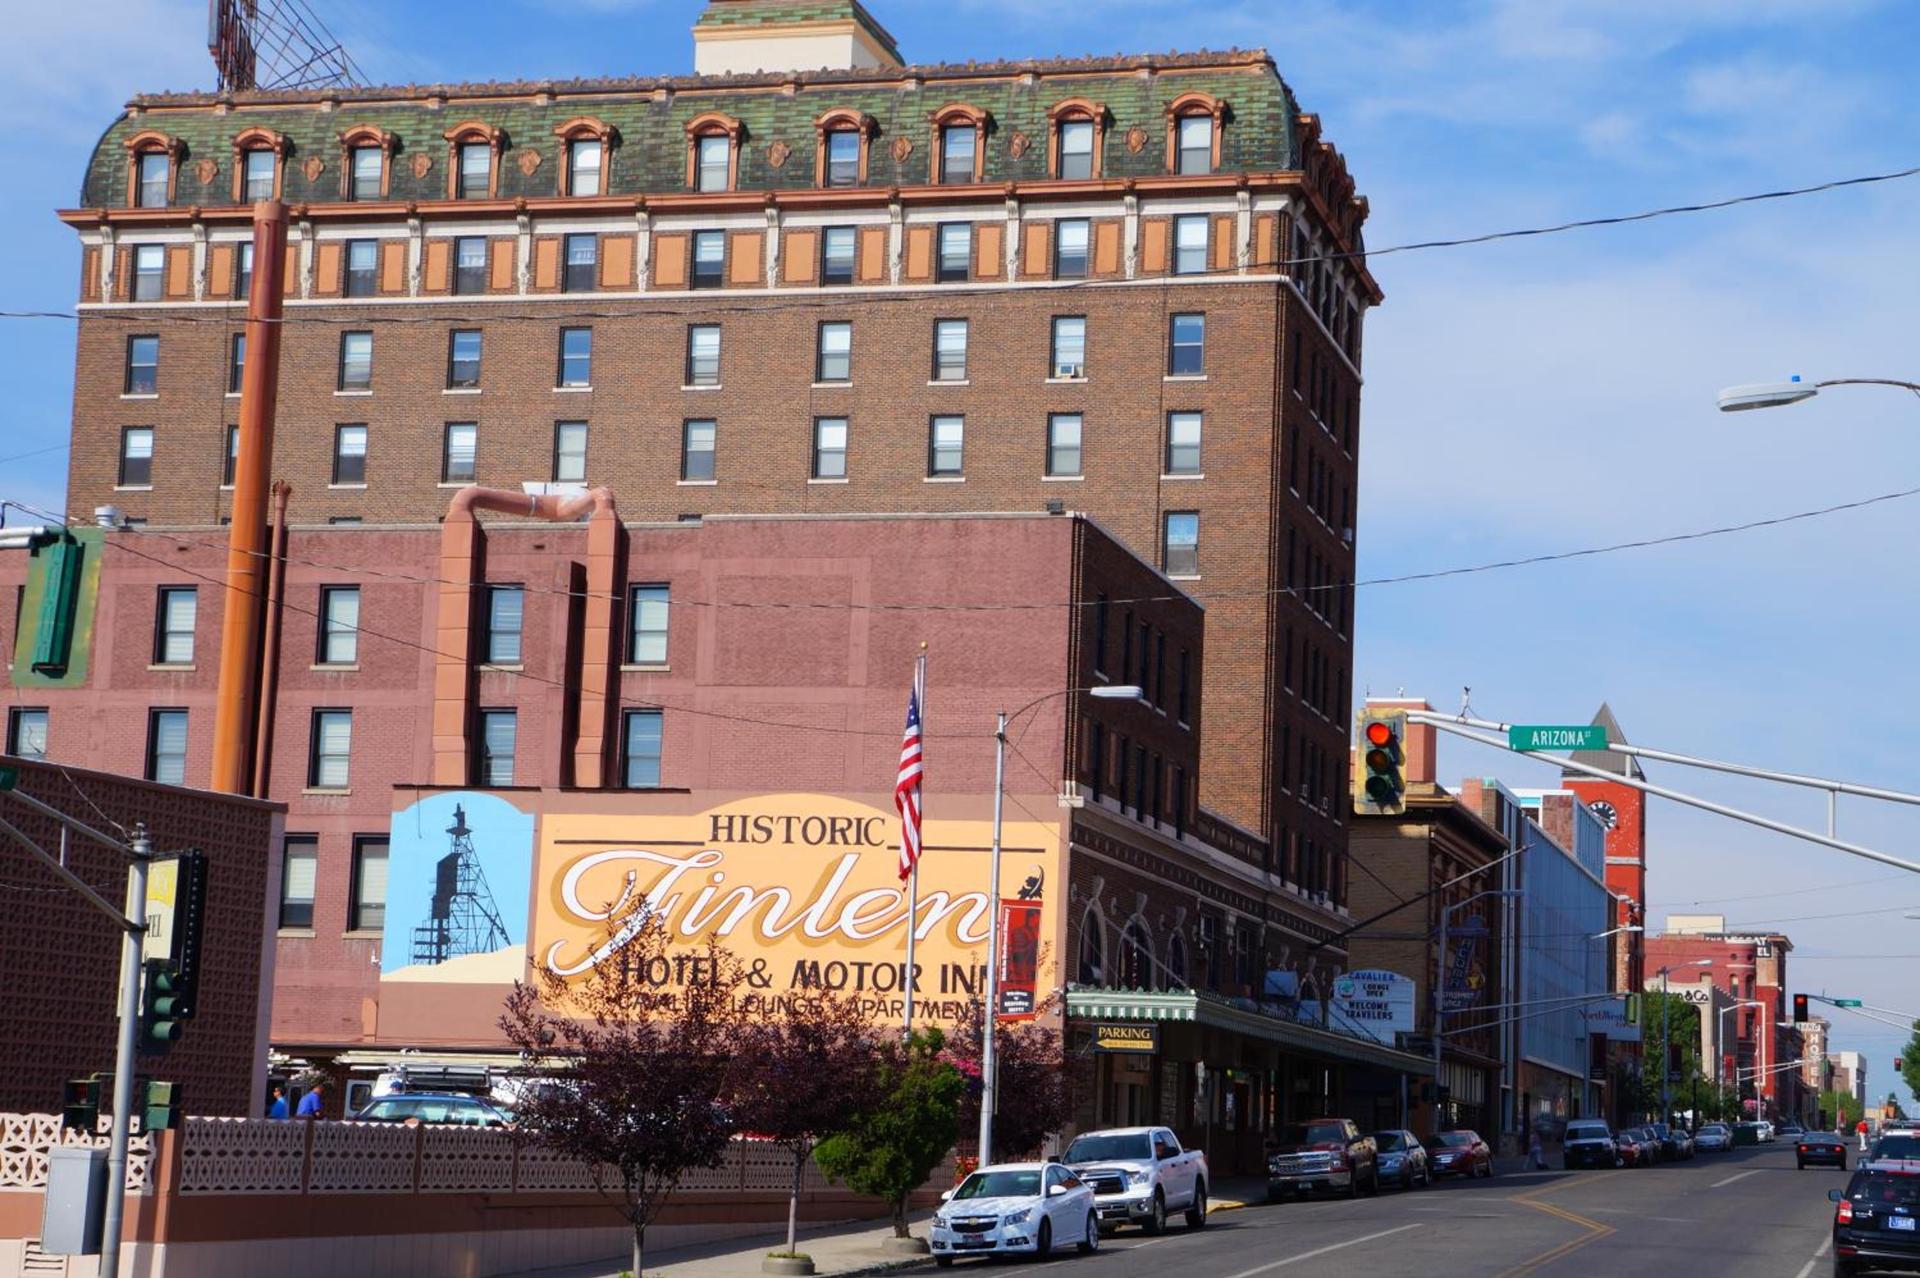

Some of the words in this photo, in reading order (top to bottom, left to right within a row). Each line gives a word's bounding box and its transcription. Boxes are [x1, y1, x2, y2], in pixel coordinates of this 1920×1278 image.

[1531, 730, 1585, 746] ARIZONA
[709, 814, 886, 847] HISTORIC
[547, 849, 989, 976] Finlen
[620, 954, 731, 989] HOTEL
[747, 957, 773, 989] &
[790, 960, 922, 993] MOTOR
[1349, 1001, 1388, 1010] WELCOME
[1345, 1010, 1393, 1020] TRAVELERS
[1098, 1026, 1151, 1039] PARKING
